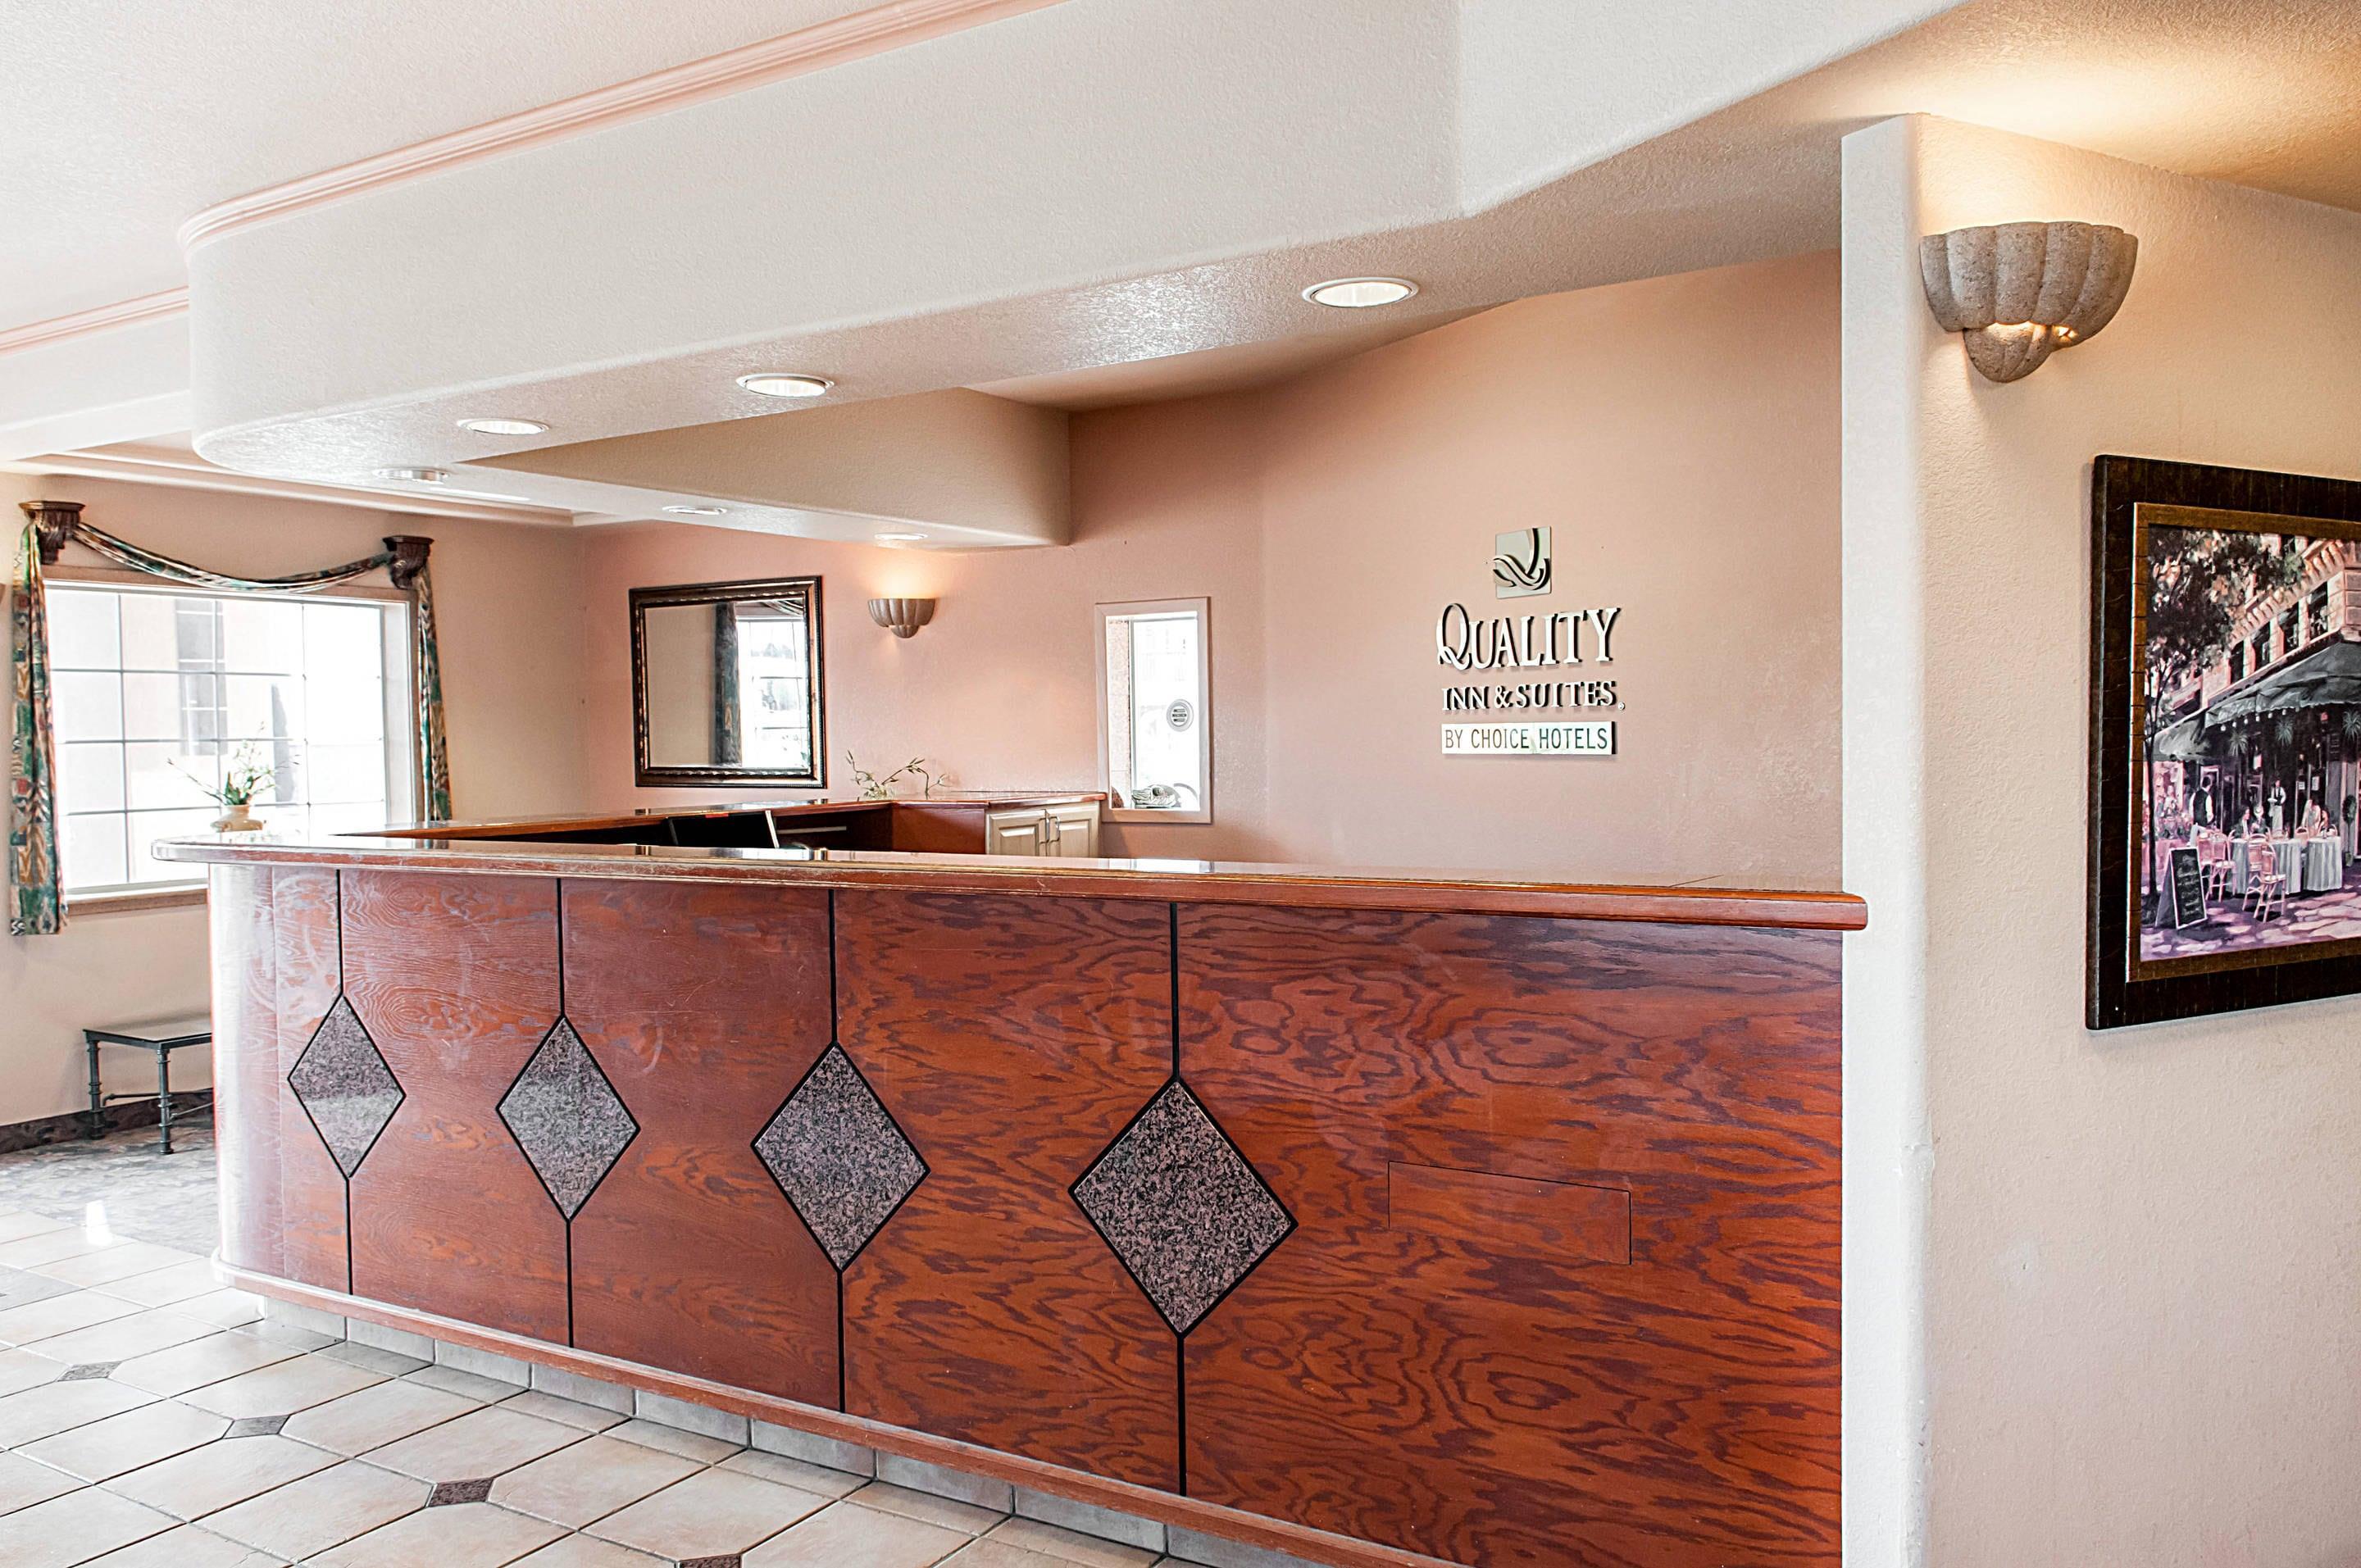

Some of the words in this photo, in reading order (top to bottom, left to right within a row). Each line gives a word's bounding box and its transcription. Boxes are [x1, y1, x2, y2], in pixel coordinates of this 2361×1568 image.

[1435, 602, 1621, 670] QUALITY
[1441, 686, 1489, 711] INN
[1494, 685, 1513, 709] &
[1516, 680, 1617, 708] SUITES
[1445, 729, 1463, 748] BY
[1471, 727, 1530, 749] CHOICE
[1539, 727, 1608, 749] HOTELS
